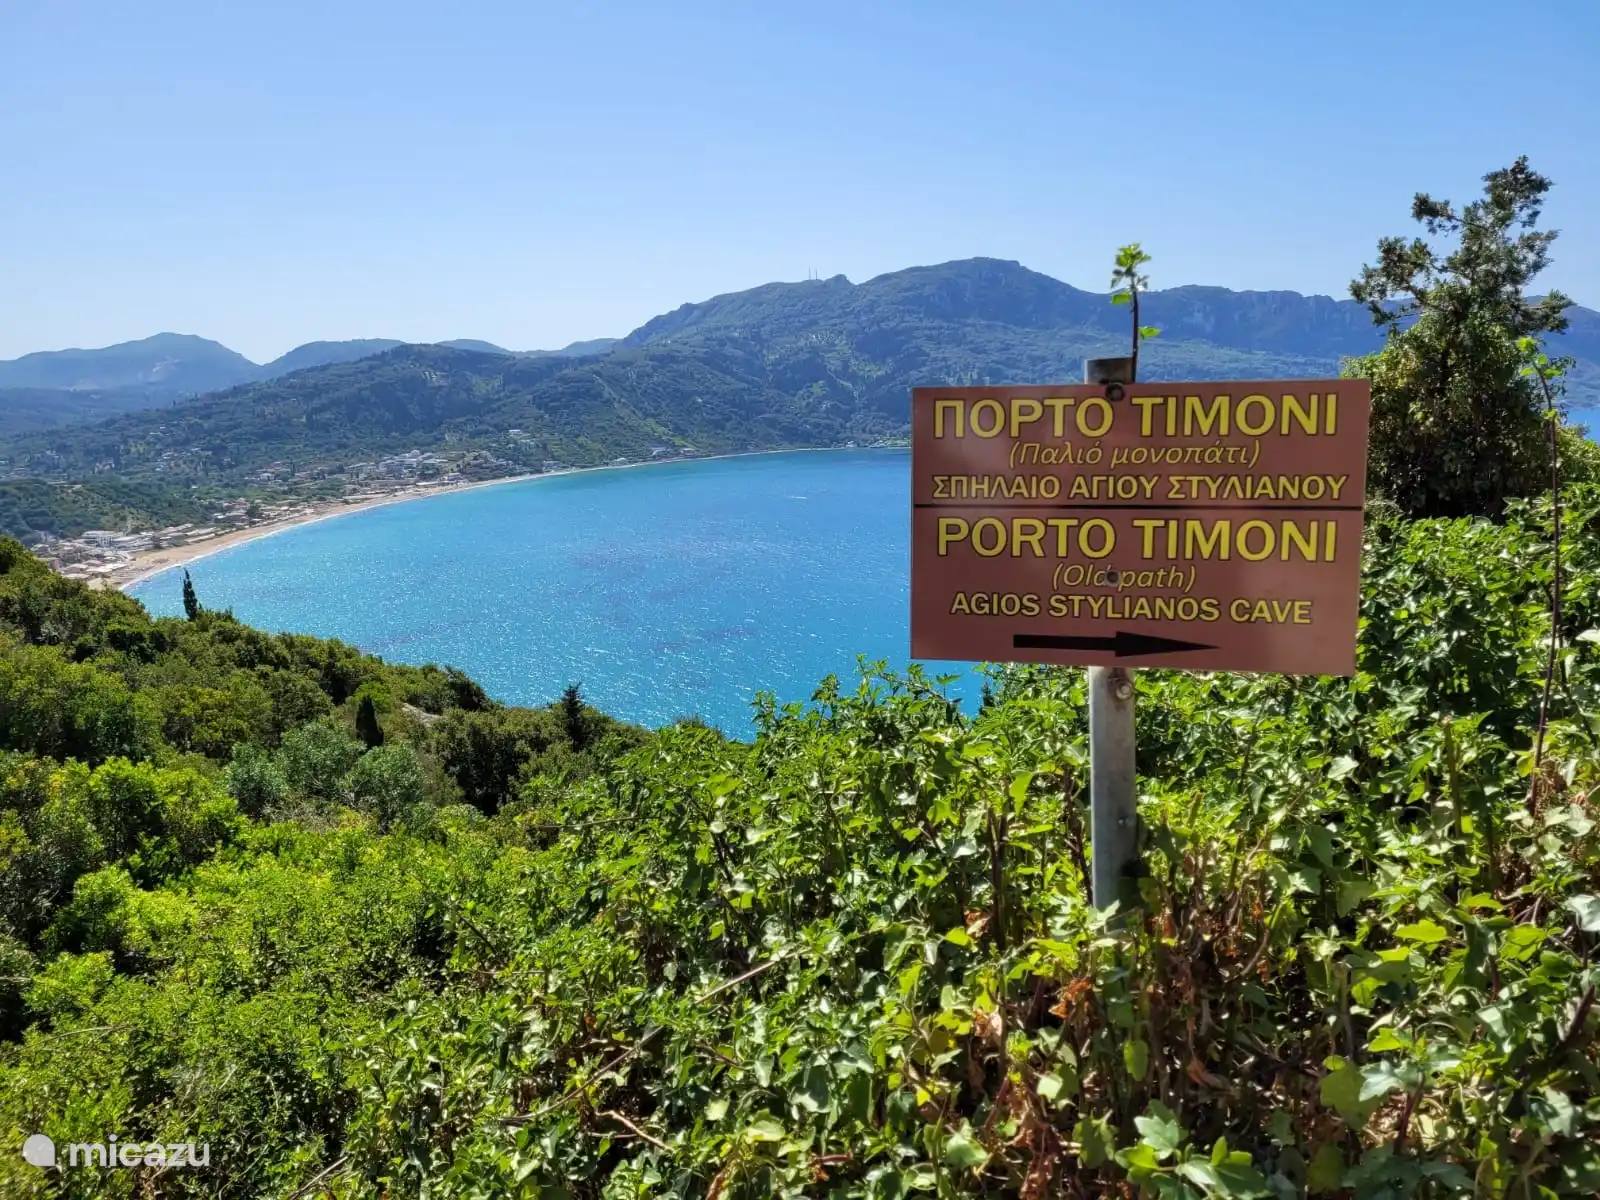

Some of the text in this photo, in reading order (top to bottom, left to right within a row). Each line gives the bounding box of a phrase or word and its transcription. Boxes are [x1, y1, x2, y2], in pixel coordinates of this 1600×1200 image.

[933, 393, 1338, 440] ΠΟΡΤΟ ΤΙΜΟΝΙ
[1008, 440, 1261, 469] (Παλιό μονοπάτι)
[932, 475, 1348, 502] ΣΠΗΛΑΙΟ ΑΓΙΟΥ ΣΤΥΛΙΑΝΟΥ
[937, 517, 1337, 562] PORTO TIMONI
[1117, 565, 1197, 592] path)
[950, 593, 1313, 624] AGIOS STYLIANOS CAVE
